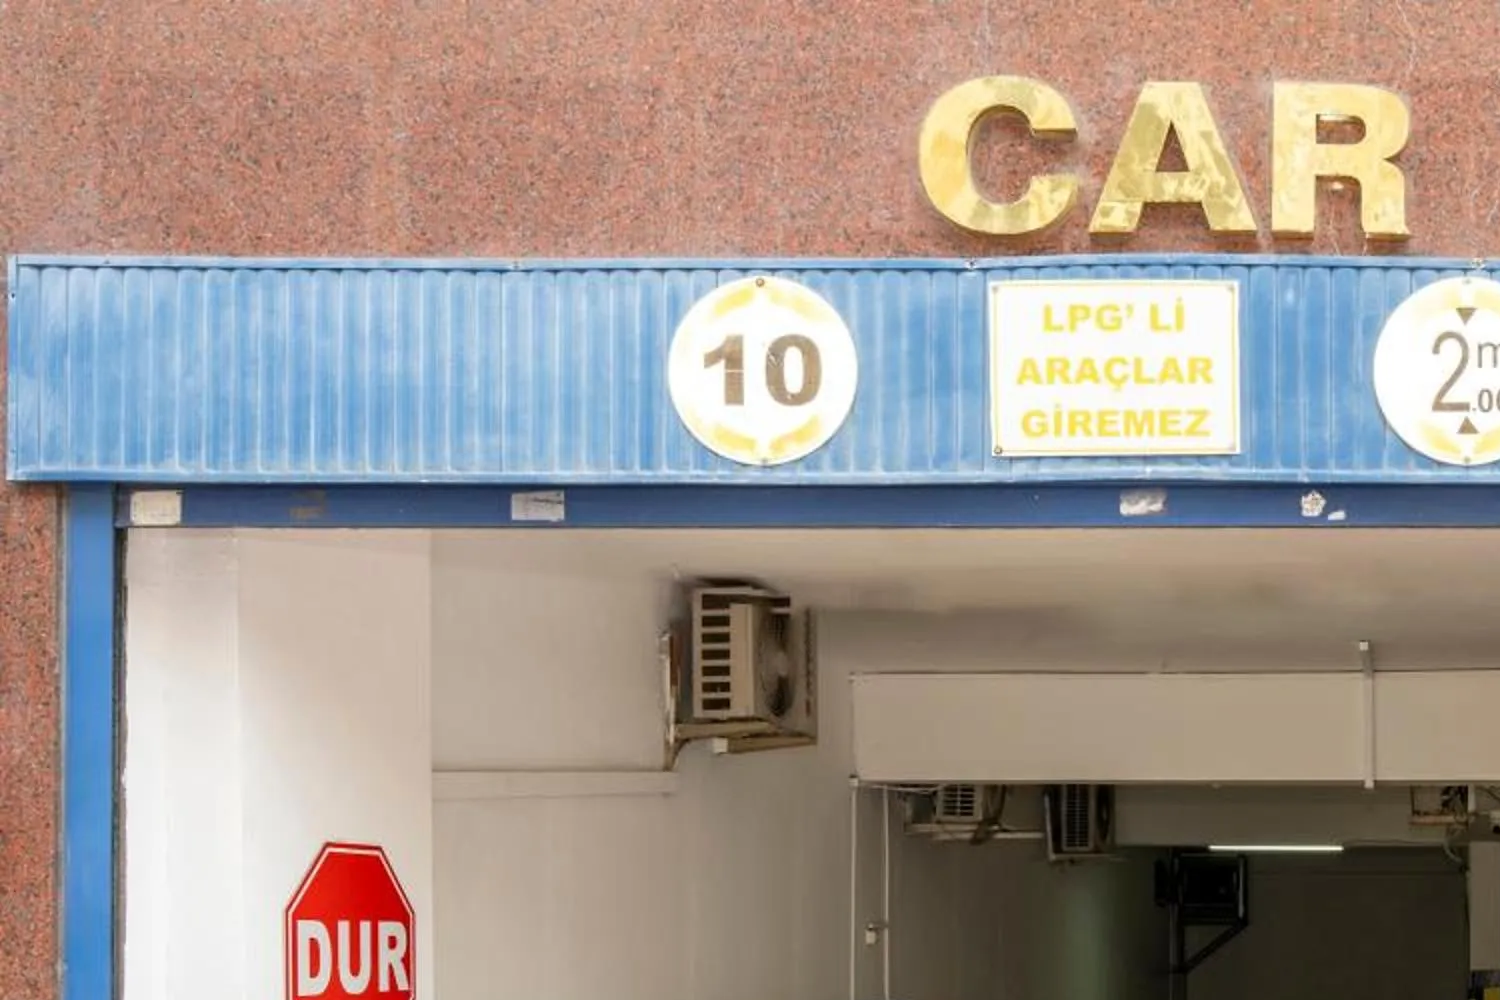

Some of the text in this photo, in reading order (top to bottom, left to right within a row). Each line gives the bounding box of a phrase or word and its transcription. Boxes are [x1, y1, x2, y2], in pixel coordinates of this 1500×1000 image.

[918, 75, 1411, 241] CAR
[1150, 296, 1186, 333] Lİ
[703, 334, 823, 407] 10
[1016, 356, 1214, 392] ARAÇLAR
[1021, 402, 1212, 439] GİREMEZ
[295, 919, 411, 997] DUR
